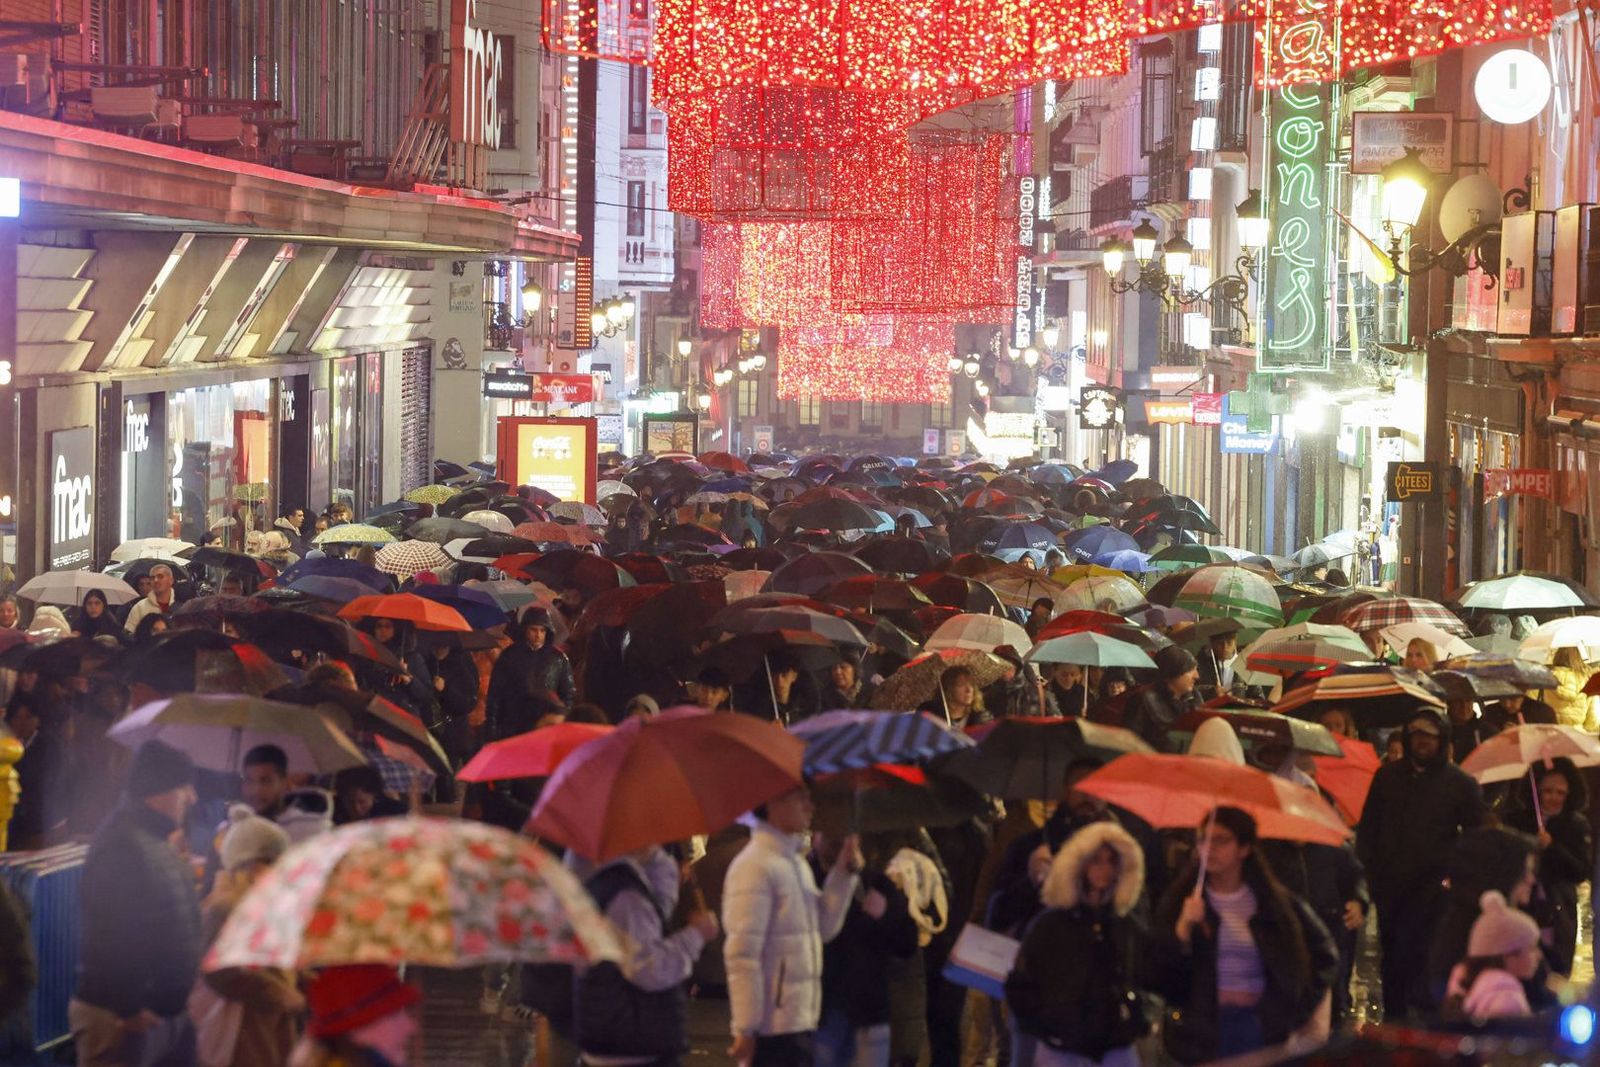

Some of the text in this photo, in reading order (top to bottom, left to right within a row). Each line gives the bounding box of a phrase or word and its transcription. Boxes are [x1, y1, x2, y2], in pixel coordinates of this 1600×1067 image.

[1269, 0, 1328, 349] acones
[1016, 177, 1034, 348] SPORT 2000
[126, 400, 149, 452] fnac
[1225, 436, 1273, 451] Money
[54, 455, 91, 543] fnac
